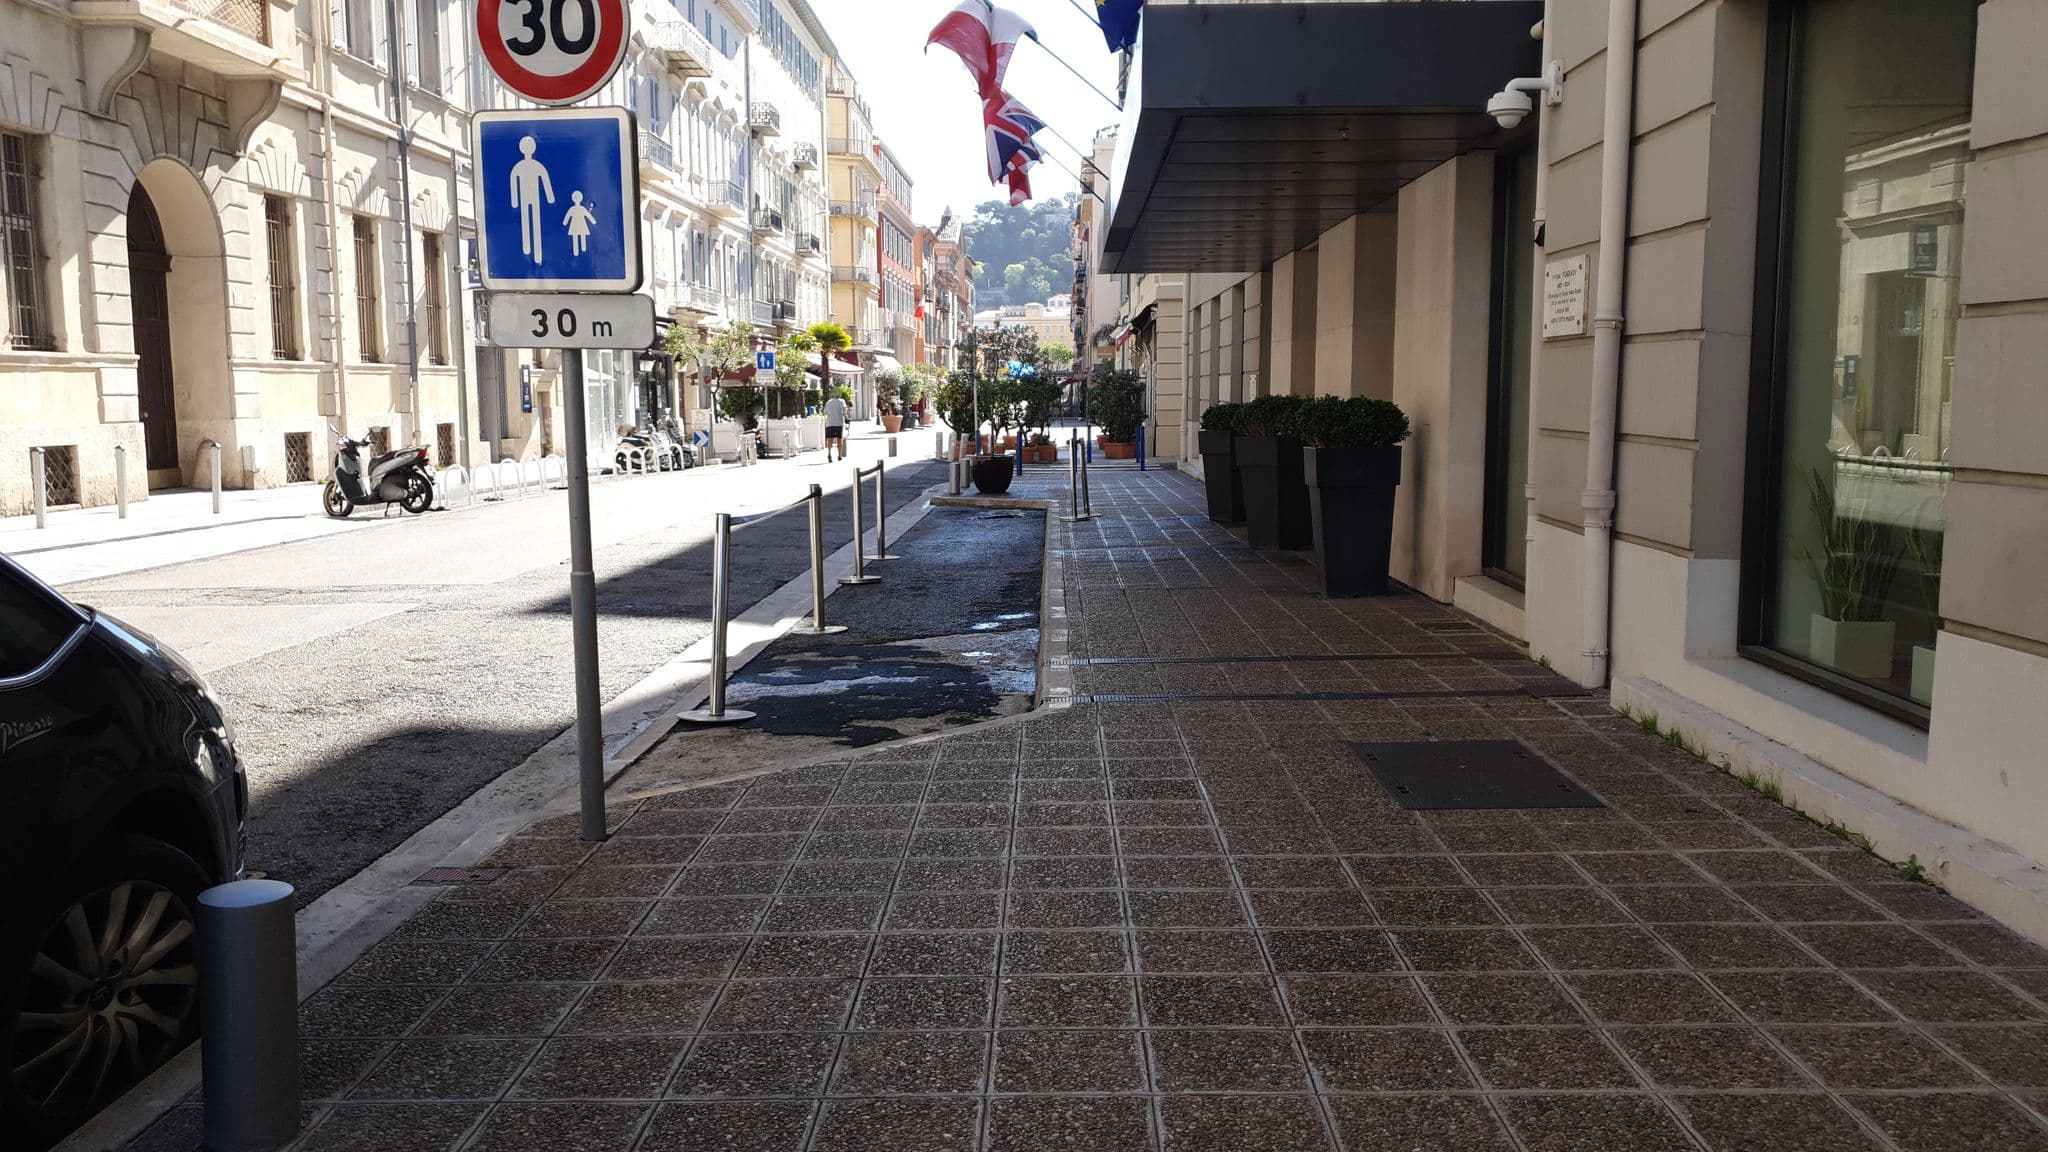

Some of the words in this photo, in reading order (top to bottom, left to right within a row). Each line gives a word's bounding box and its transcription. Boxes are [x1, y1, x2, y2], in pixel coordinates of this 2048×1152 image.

[505, 0, 596, 56] 30
[531, 308, 577, 338] 30
[592, 320, 613, 337] m
